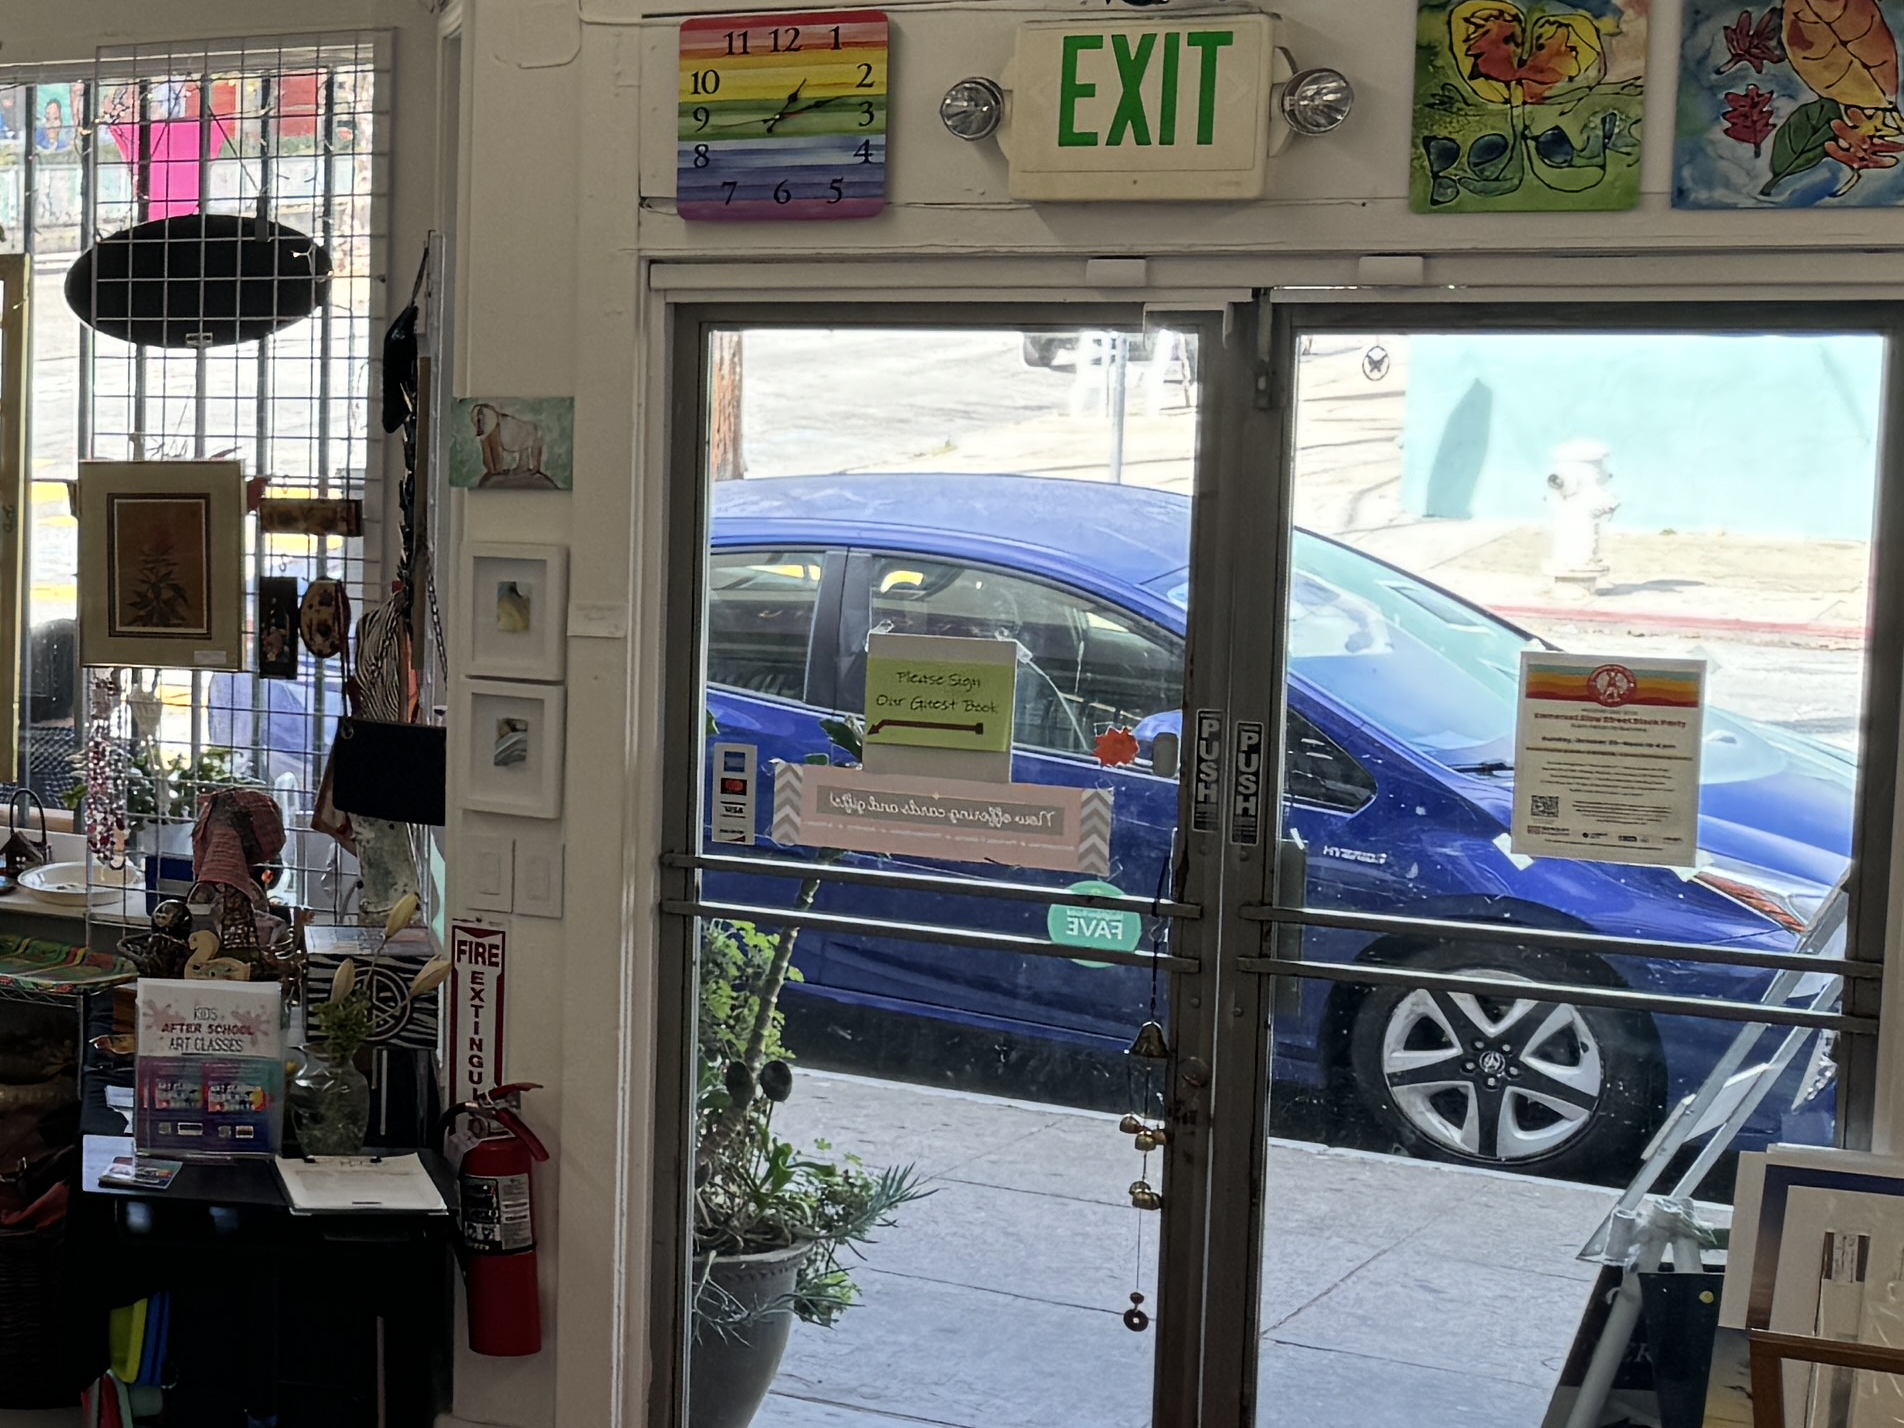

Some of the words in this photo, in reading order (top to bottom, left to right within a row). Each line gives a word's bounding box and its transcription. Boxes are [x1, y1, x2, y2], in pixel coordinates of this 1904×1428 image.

[723, 30, 750, 56] 11
[768, 27, 803, 53] 12
[828, 25, 842, 51] 1
[690, 69, 721, 95] 10
[855, 62, 875, 89] 2
[1058, 31, 1234, 147] EXIT
[692, 106, 710, 133] 9
[857, 101, 875, 128] 3
[693, 143, 710, 169] 8
[853, 139, 874, 165] 4
[720, 180, 738, 206] 7
[773, 179, 792, 205] 6
[826, 176, 844, 204] 5
[896, 670, 946, 687] Please
[948, 672, 981, 693] Sign
[876, 694, 902, 709] Our
[909, 694, 957, 713] Guest
[963, 699, 998, 715] Book
[1197, 719, 1220, 803] PUSH
[1236, 732, 1260, 816] PUSH
[456, 939, 501, 968] FIRE
[161, 1023, 202, 1034] AFTER
[208, 1023, 255, 1036] SCHOOL
[169, 1037, 191, 1050] ART
[194, 1037, 244, 1052] CLASSES
